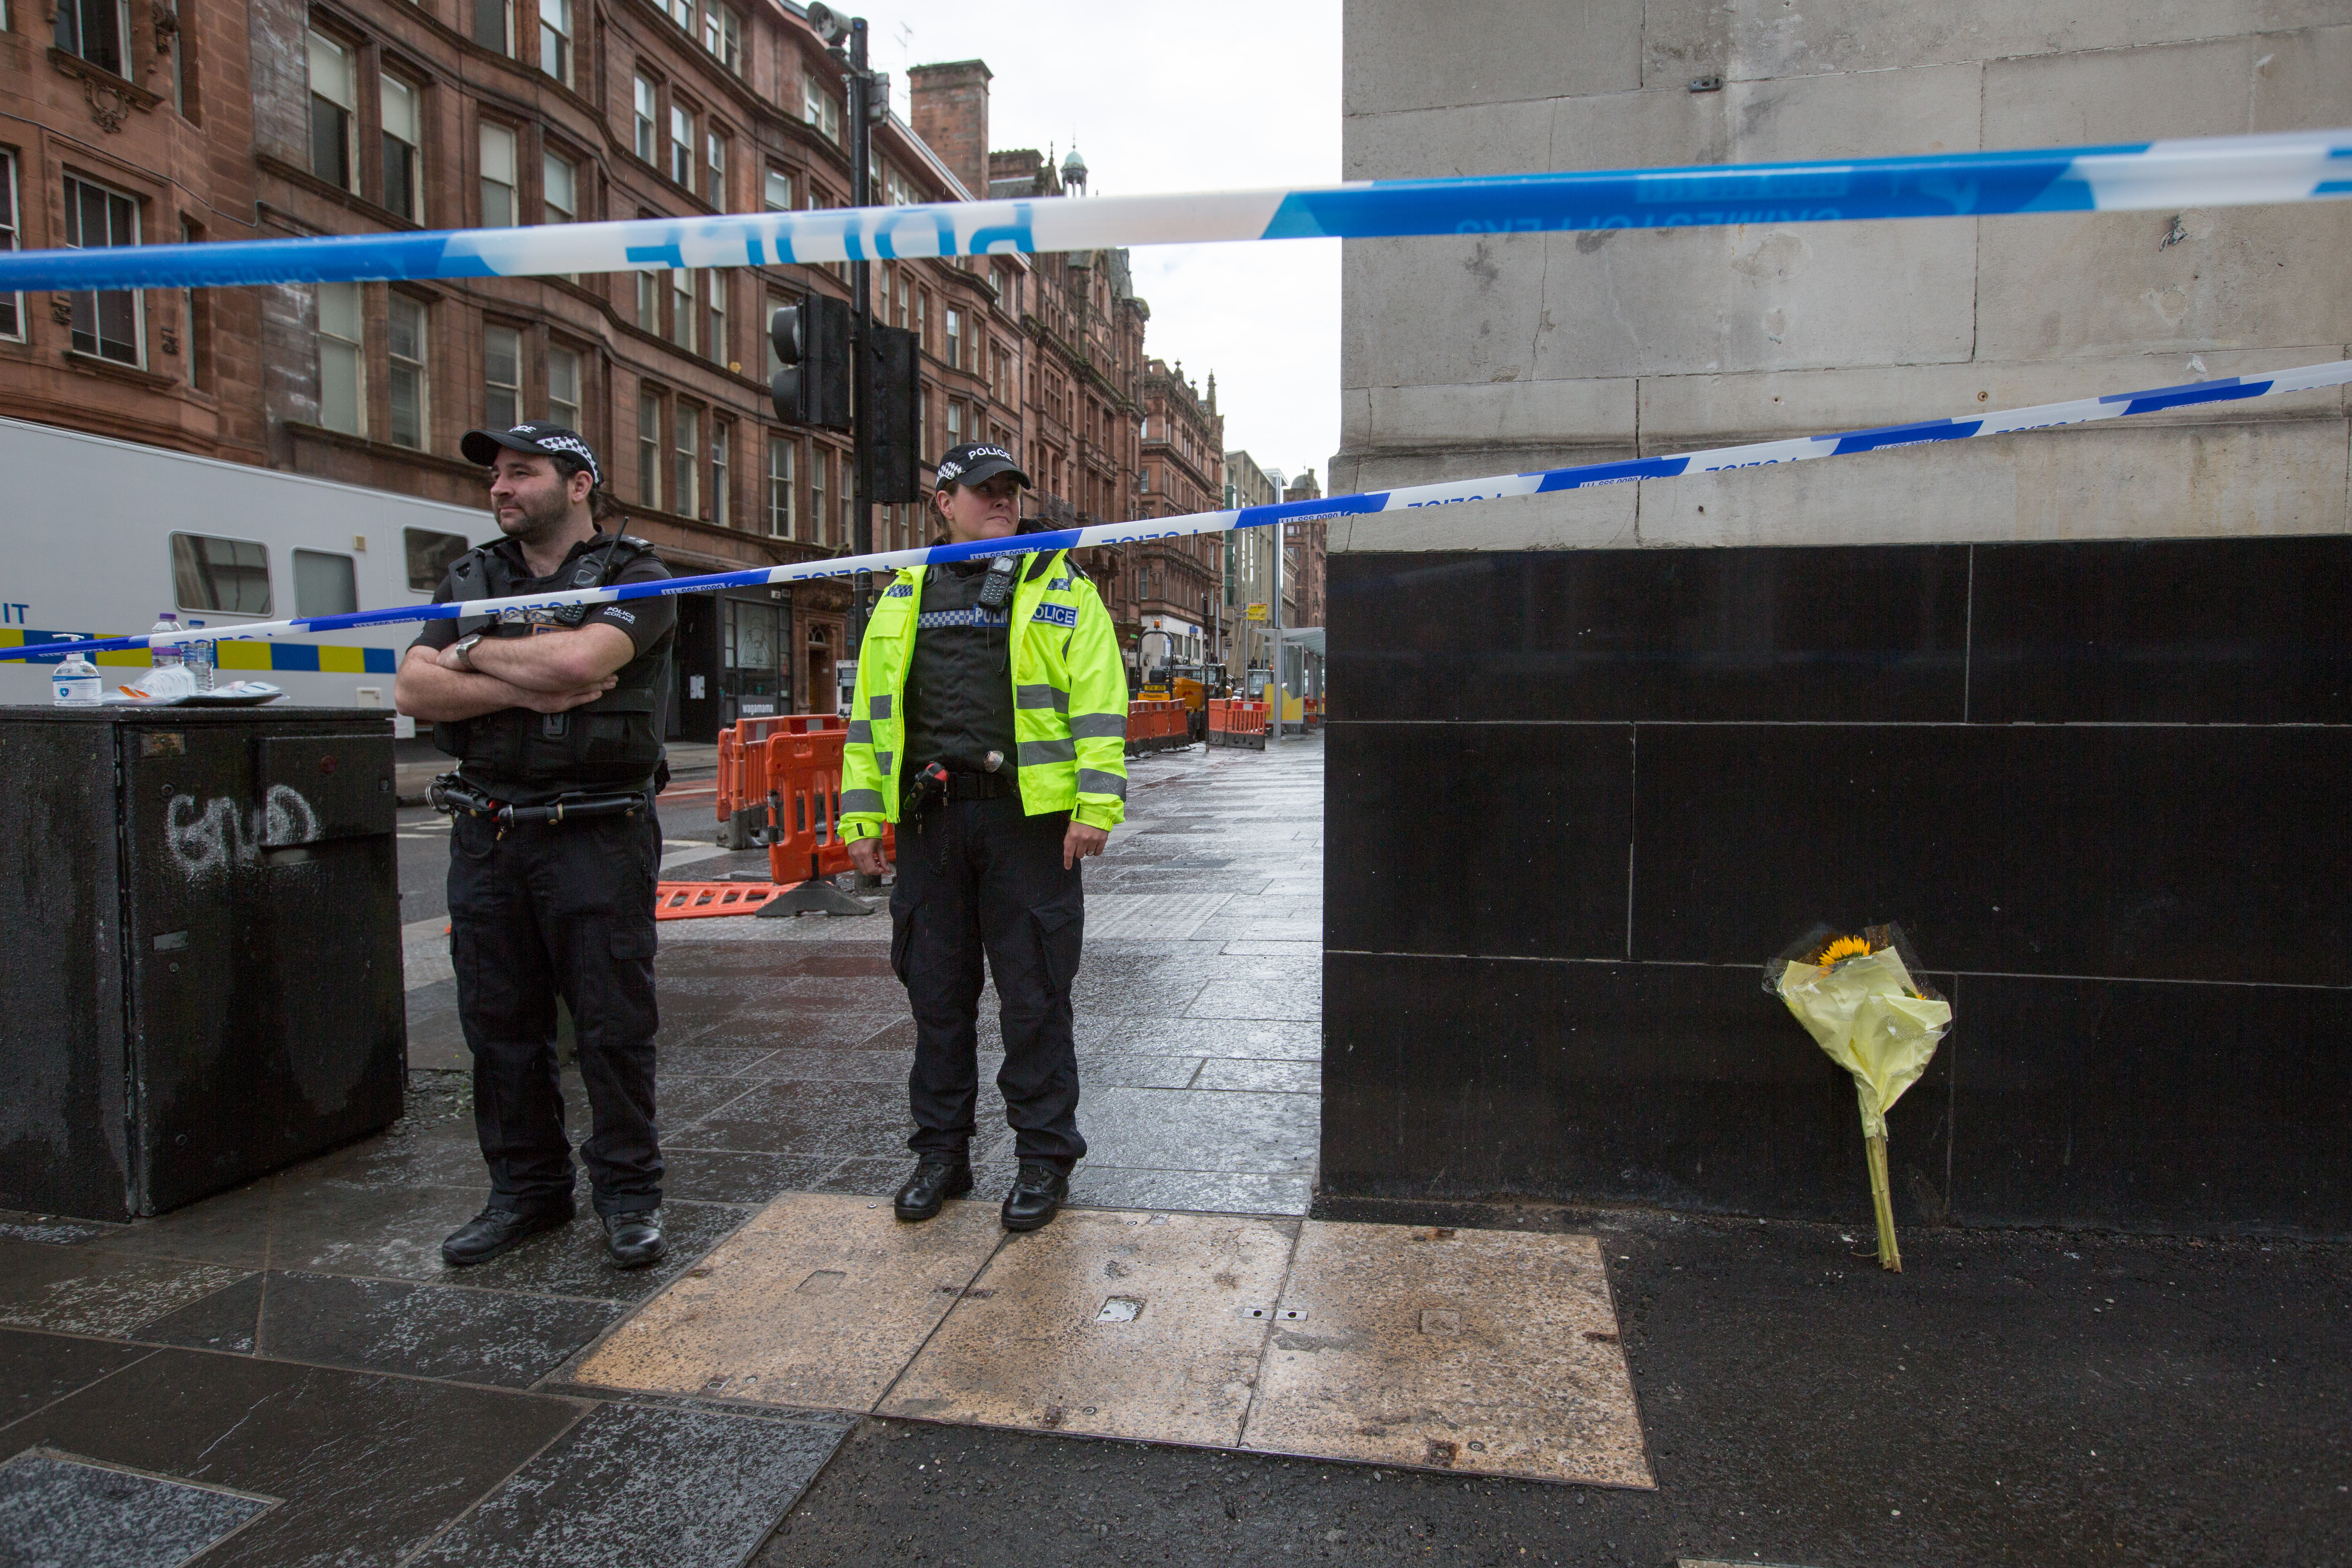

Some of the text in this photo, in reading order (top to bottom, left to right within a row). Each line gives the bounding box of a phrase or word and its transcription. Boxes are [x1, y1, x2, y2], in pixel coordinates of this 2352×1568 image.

[968, 447, 1013, 461] POLICE
[0, 603, 29, 624] IT
[604, 611, 634, 624] SCOTLAND
[607, 607, 636, 621] POLICE
[742, 704, 773, 716] wagamama
